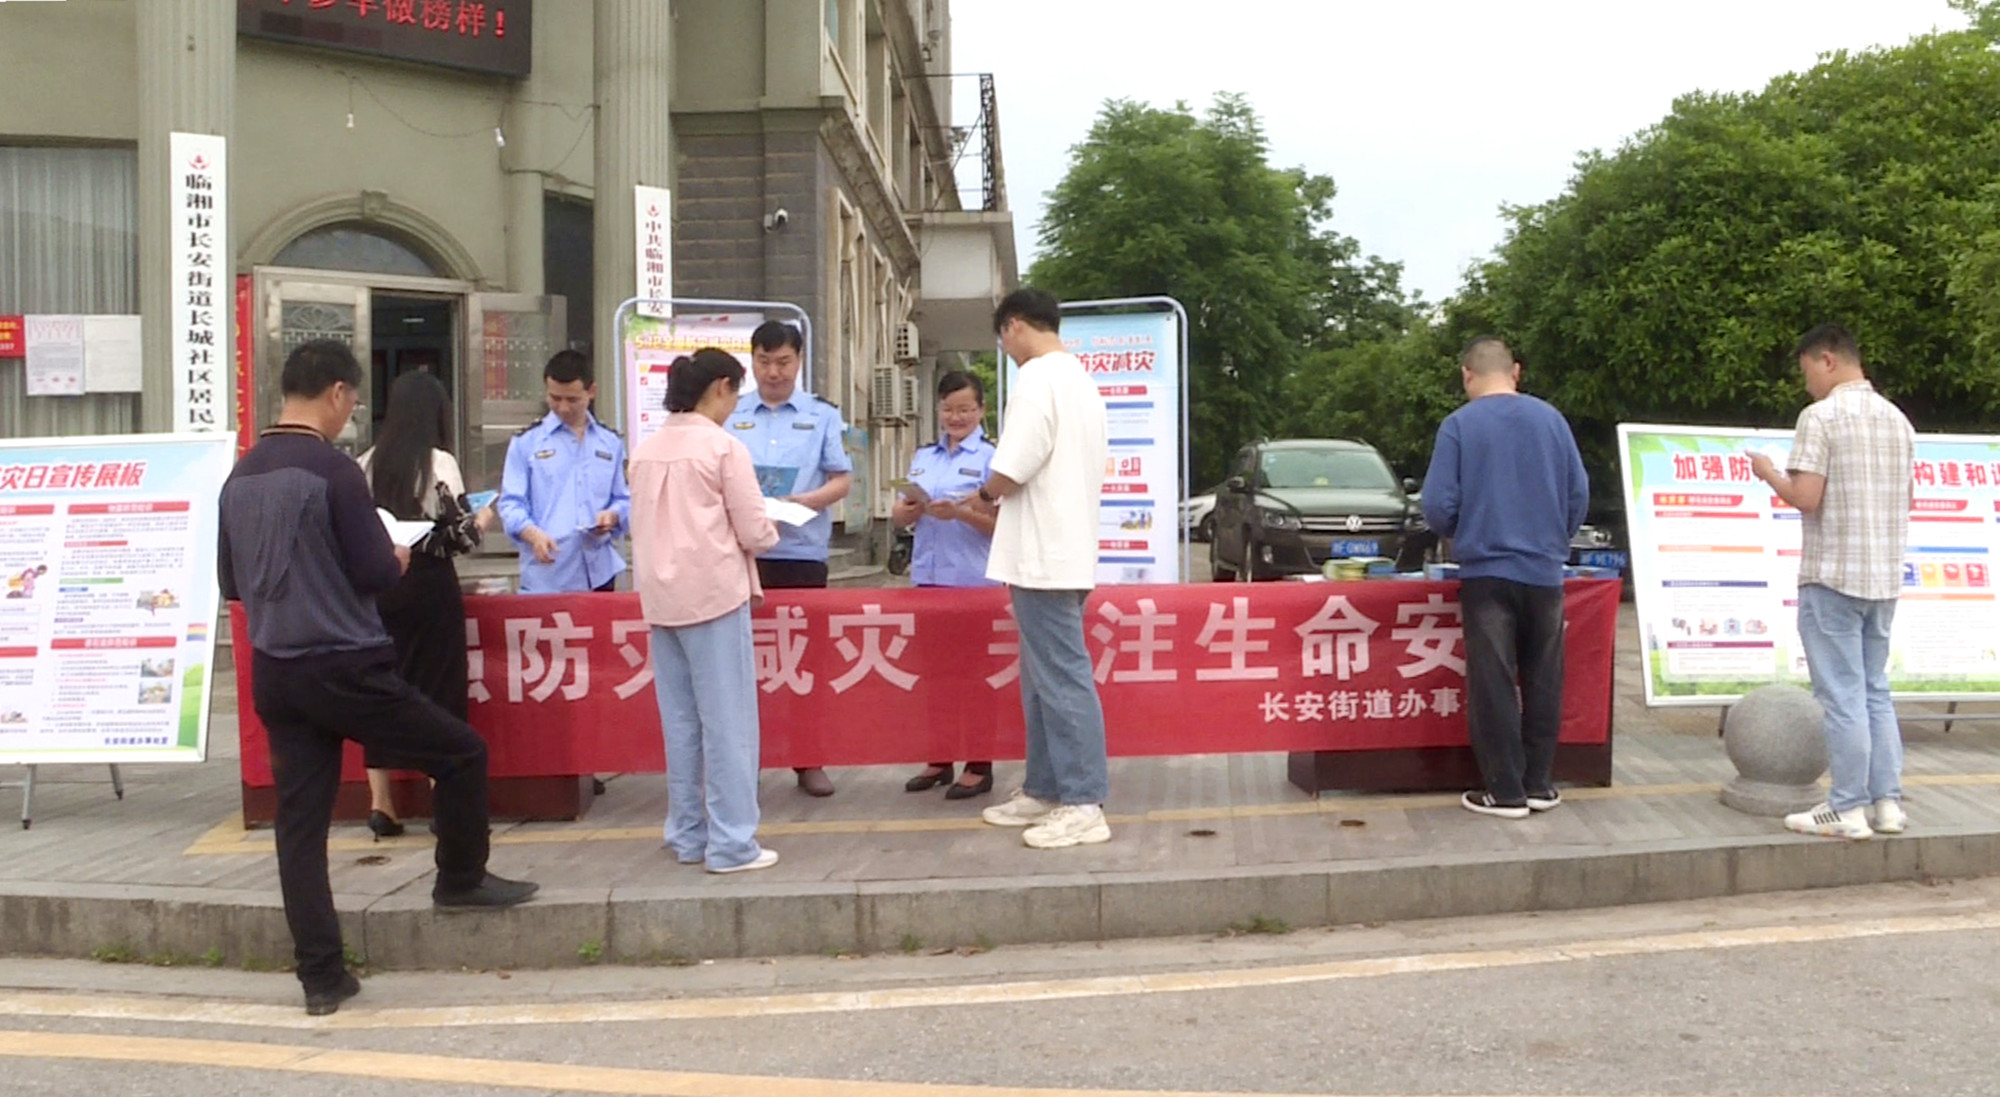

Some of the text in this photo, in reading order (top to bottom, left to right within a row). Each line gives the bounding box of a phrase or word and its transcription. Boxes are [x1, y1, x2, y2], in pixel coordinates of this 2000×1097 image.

[186, 173, 214, 432] 临湘市长安街道长城社区居民
[0, 462, 147, 490] 灾日宣传展板
[1673, 453, 1766, 482] 加强防
[466, 593, 1569, 703] 防减灾 注生命安
[1258, 687, 1467, 723] 长安街道办事
